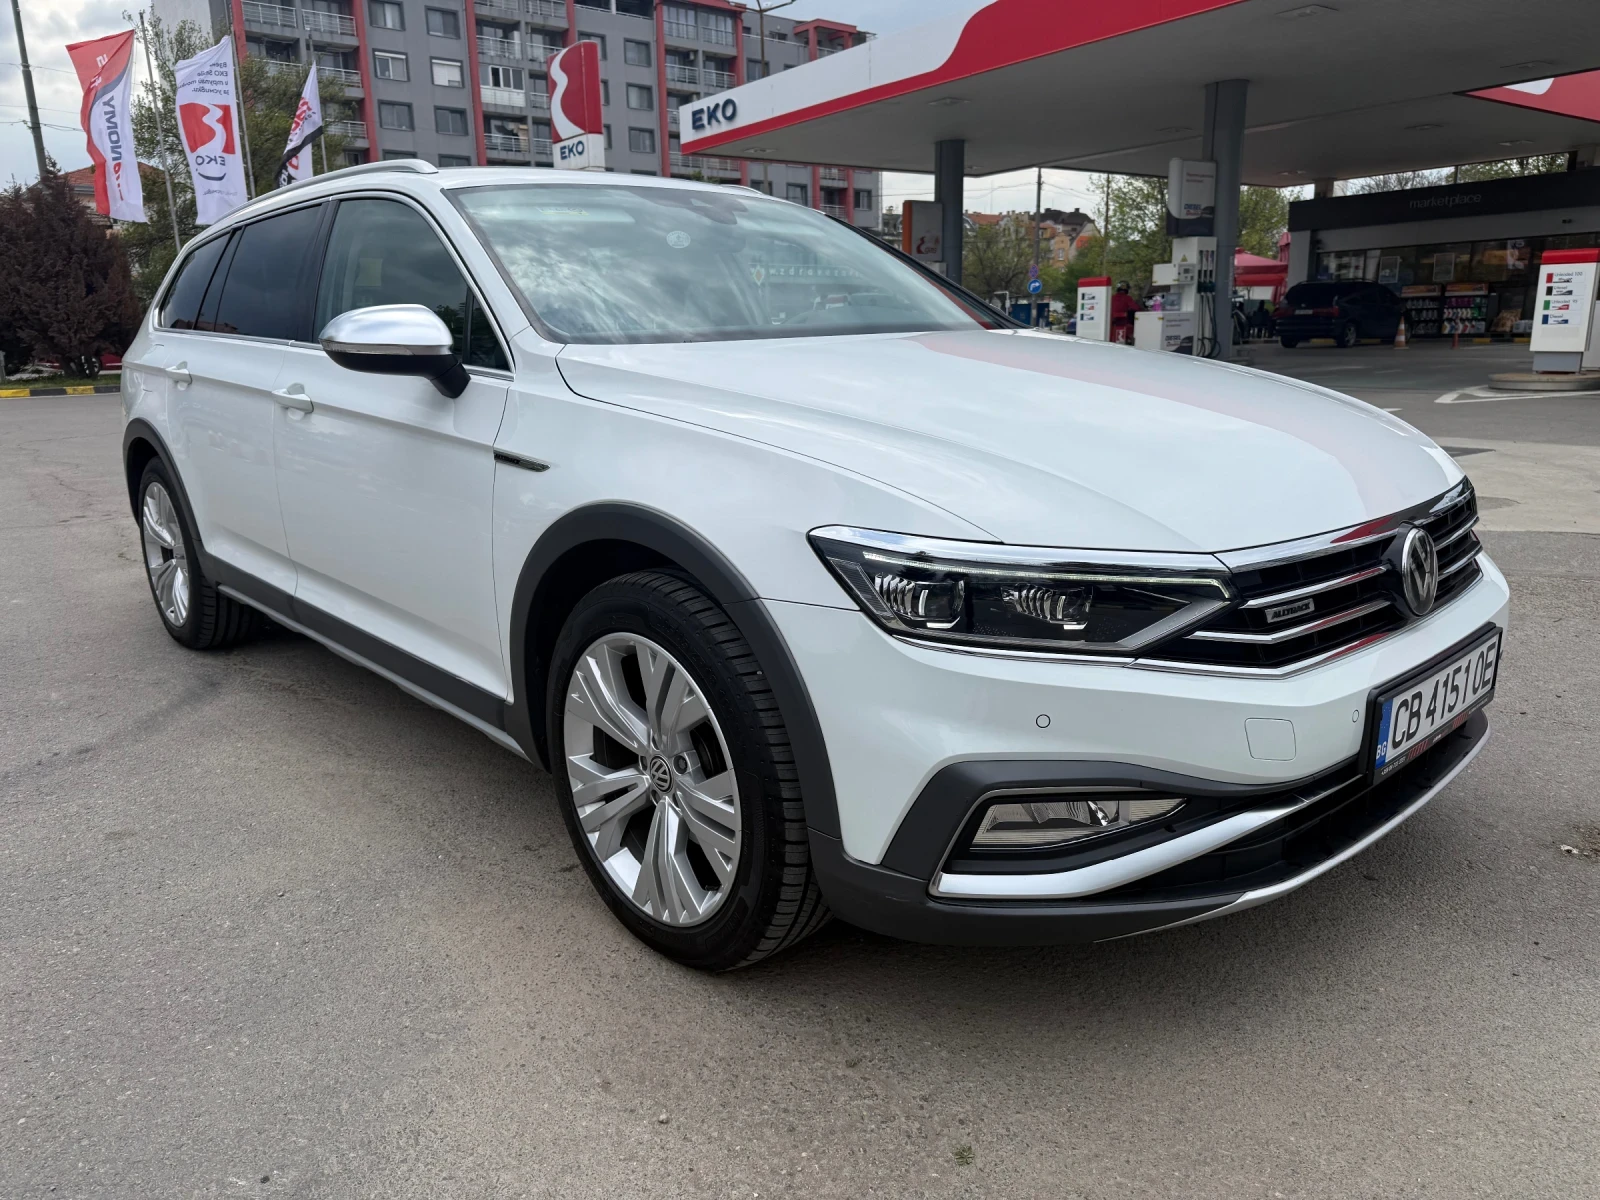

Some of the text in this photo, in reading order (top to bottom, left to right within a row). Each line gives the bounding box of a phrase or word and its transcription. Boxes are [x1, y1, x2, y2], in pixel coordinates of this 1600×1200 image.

[691, 98, 737, 131] EKO
[559, 140, 585, 160] EKO
[1409, 193, 1482, 208] marketplace
[1392, 641, 1496, 750] CB 4151 OE
[1376, 741, 1387, 760] BG
